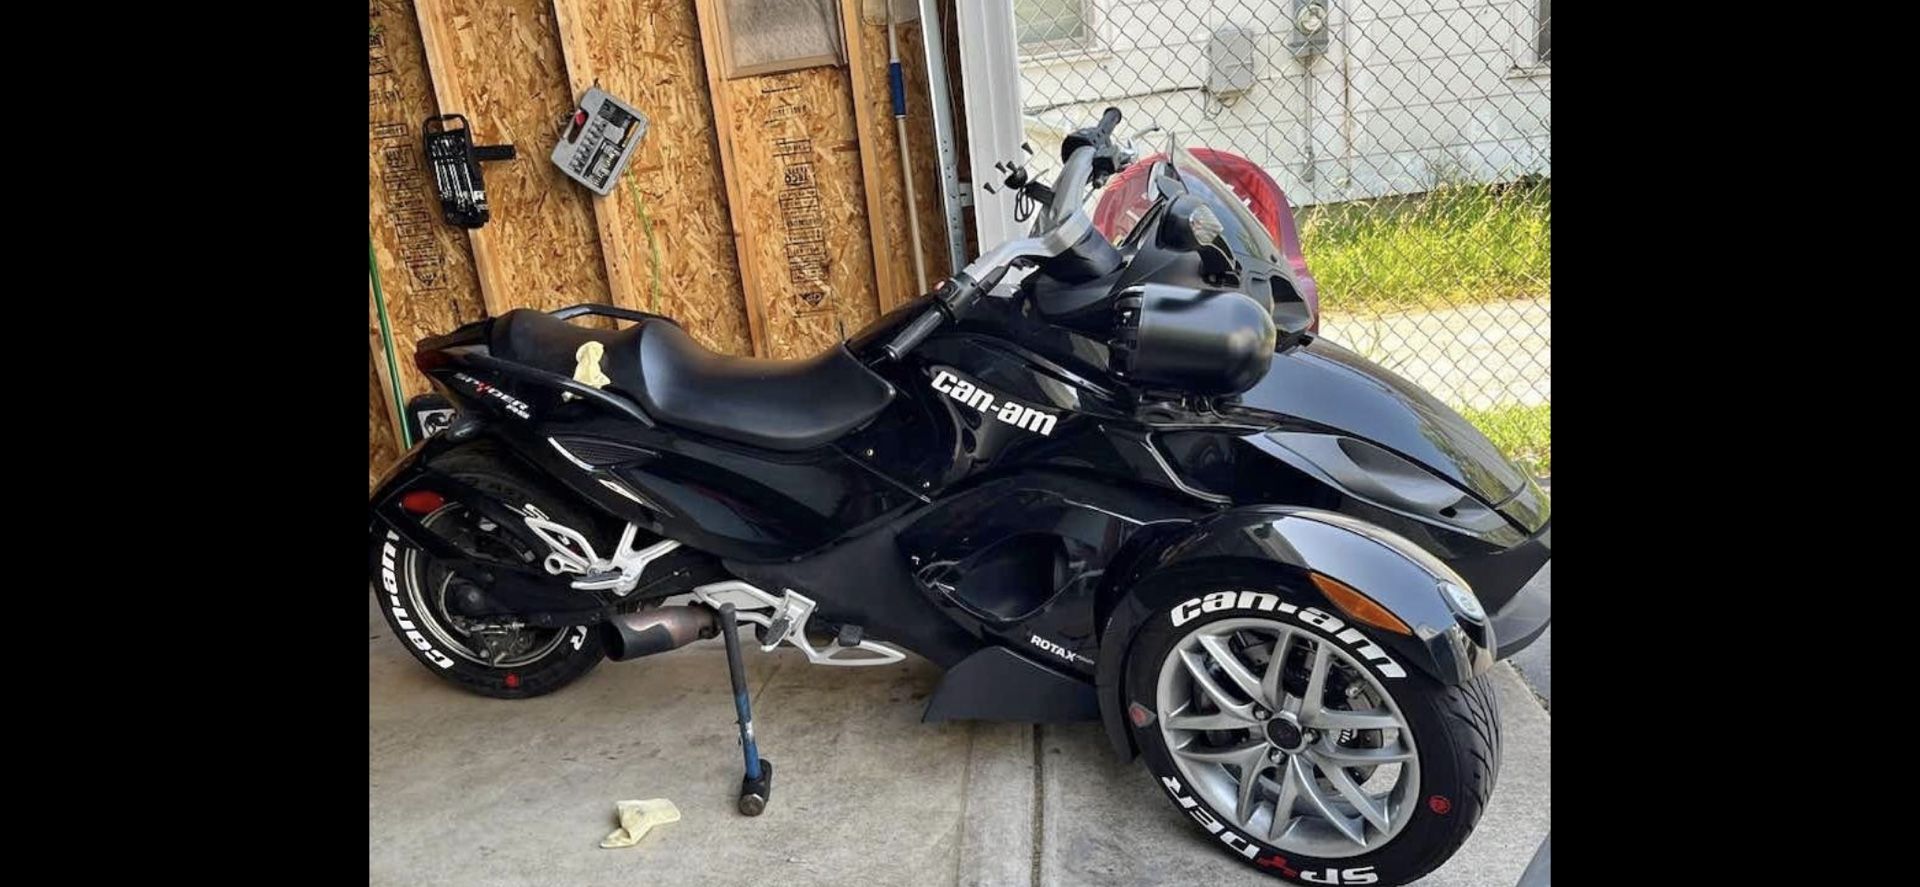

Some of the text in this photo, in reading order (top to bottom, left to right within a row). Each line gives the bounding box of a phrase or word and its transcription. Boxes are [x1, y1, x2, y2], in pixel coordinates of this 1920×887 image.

[931, 370, 1058, 436] can-am
[1030, 635, 1077, 662] ROTAX
[1162, 776, 1379, 885] SPYDER
